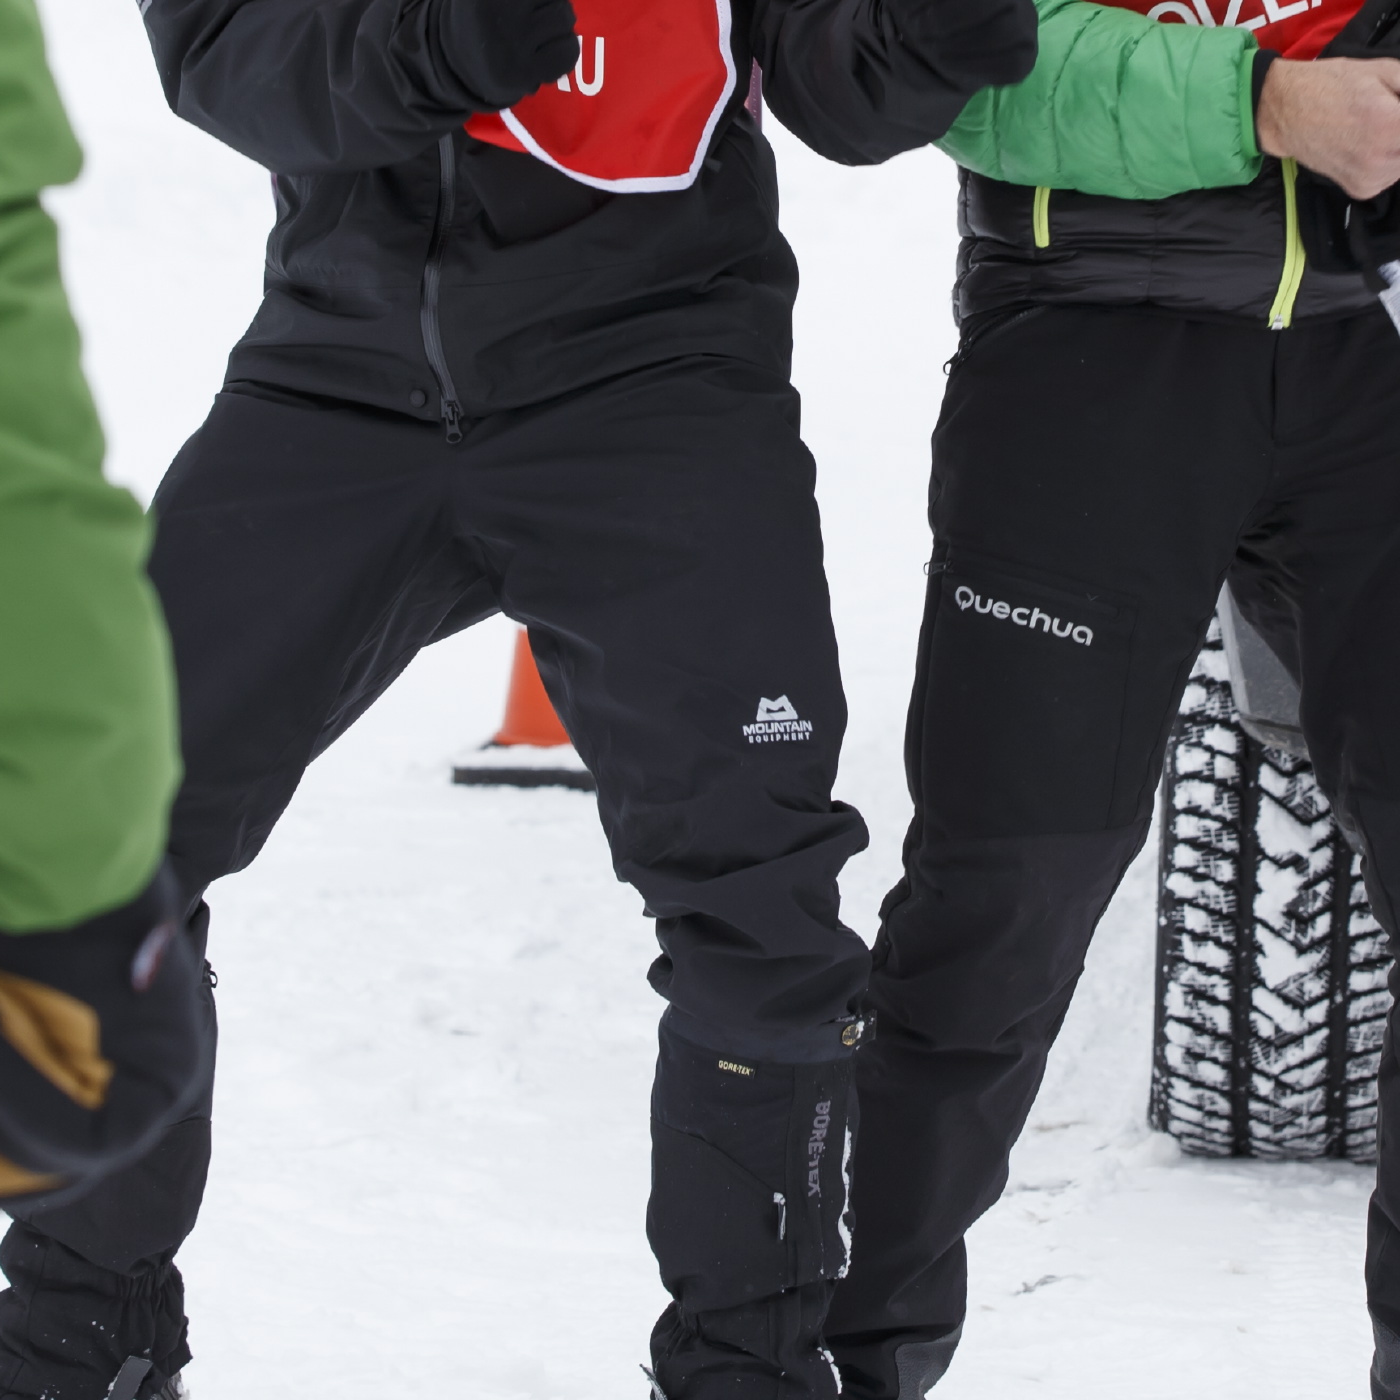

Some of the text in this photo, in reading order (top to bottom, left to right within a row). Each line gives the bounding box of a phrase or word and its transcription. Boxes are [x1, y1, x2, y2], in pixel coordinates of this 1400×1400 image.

[955, 586, 1093, 646] Quechua
[742, 720, 813, 736] MOUNTAIN
[748, 732, 810, 744] EQUIPMENT
